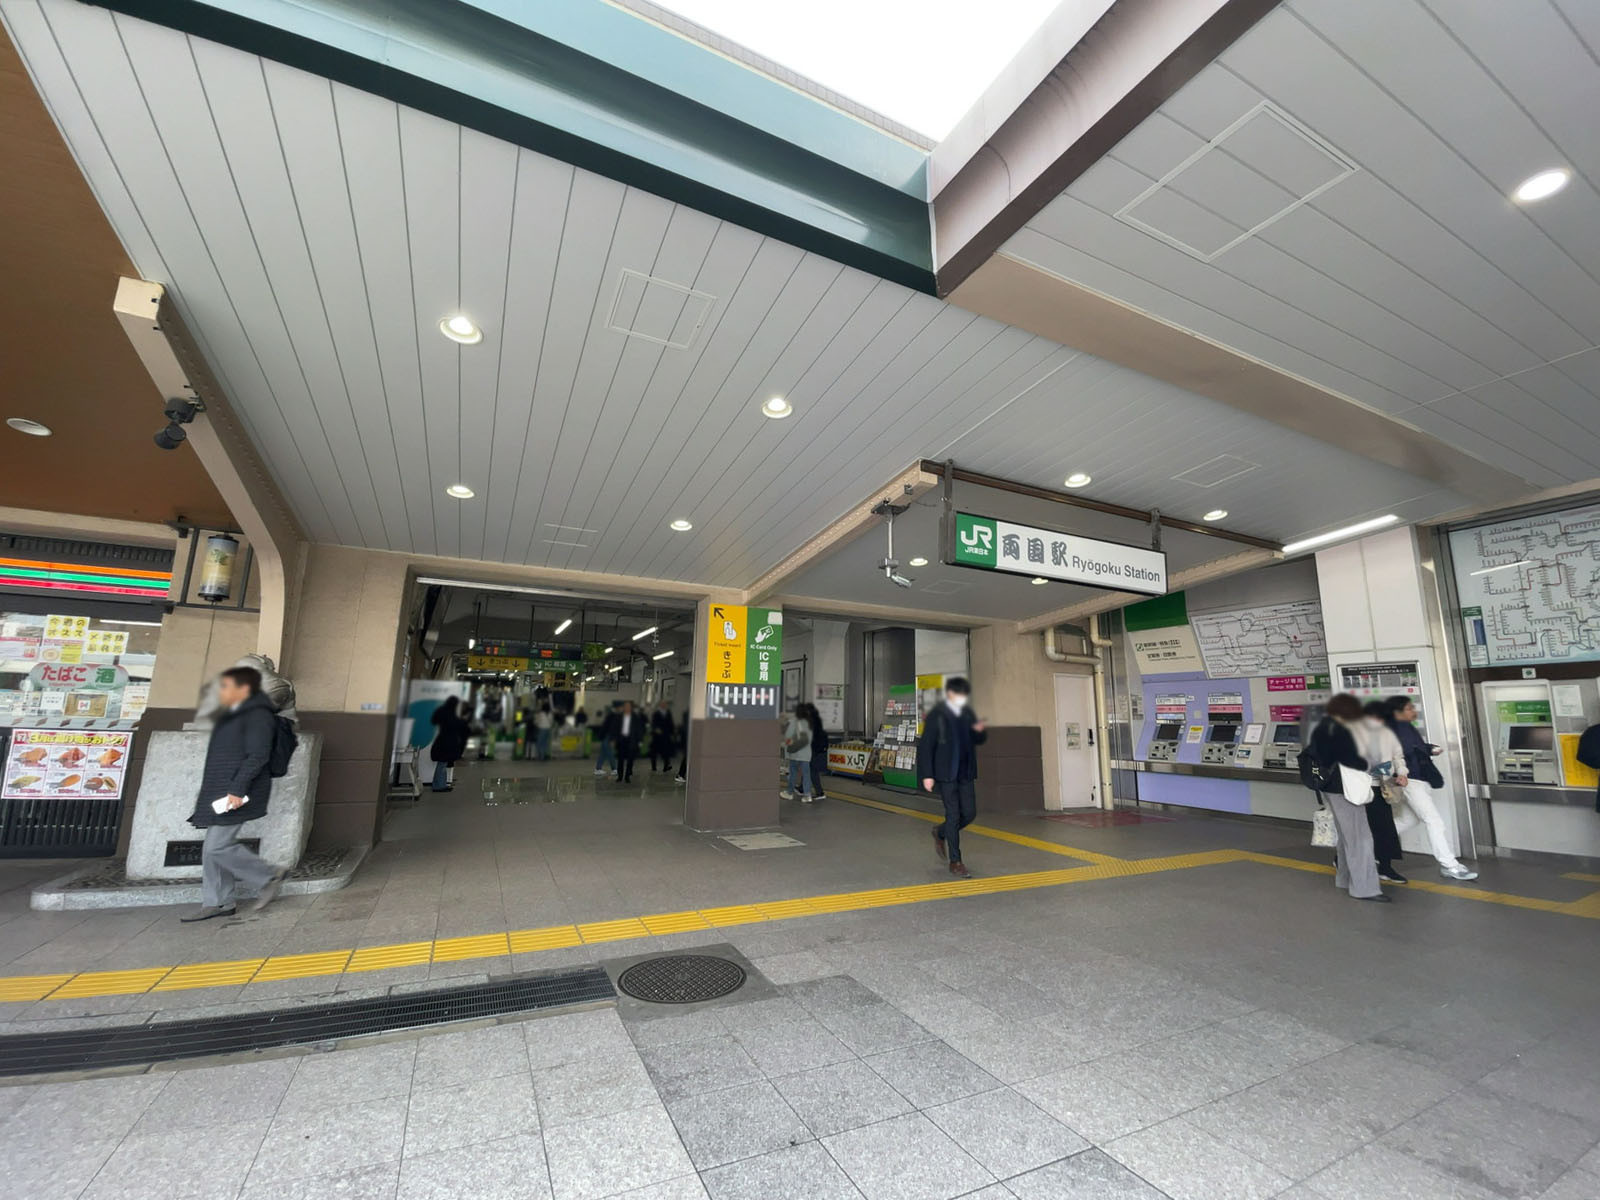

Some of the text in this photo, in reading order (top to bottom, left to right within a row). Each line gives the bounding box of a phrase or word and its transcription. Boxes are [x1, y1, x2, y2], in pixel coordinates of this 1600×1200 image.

[960, 524, 992, 549] JR
[1002, 533, 1160, 582] 両国駅 Ryōgoku Station
[41, 665, 116, 683] たばこ 酒
